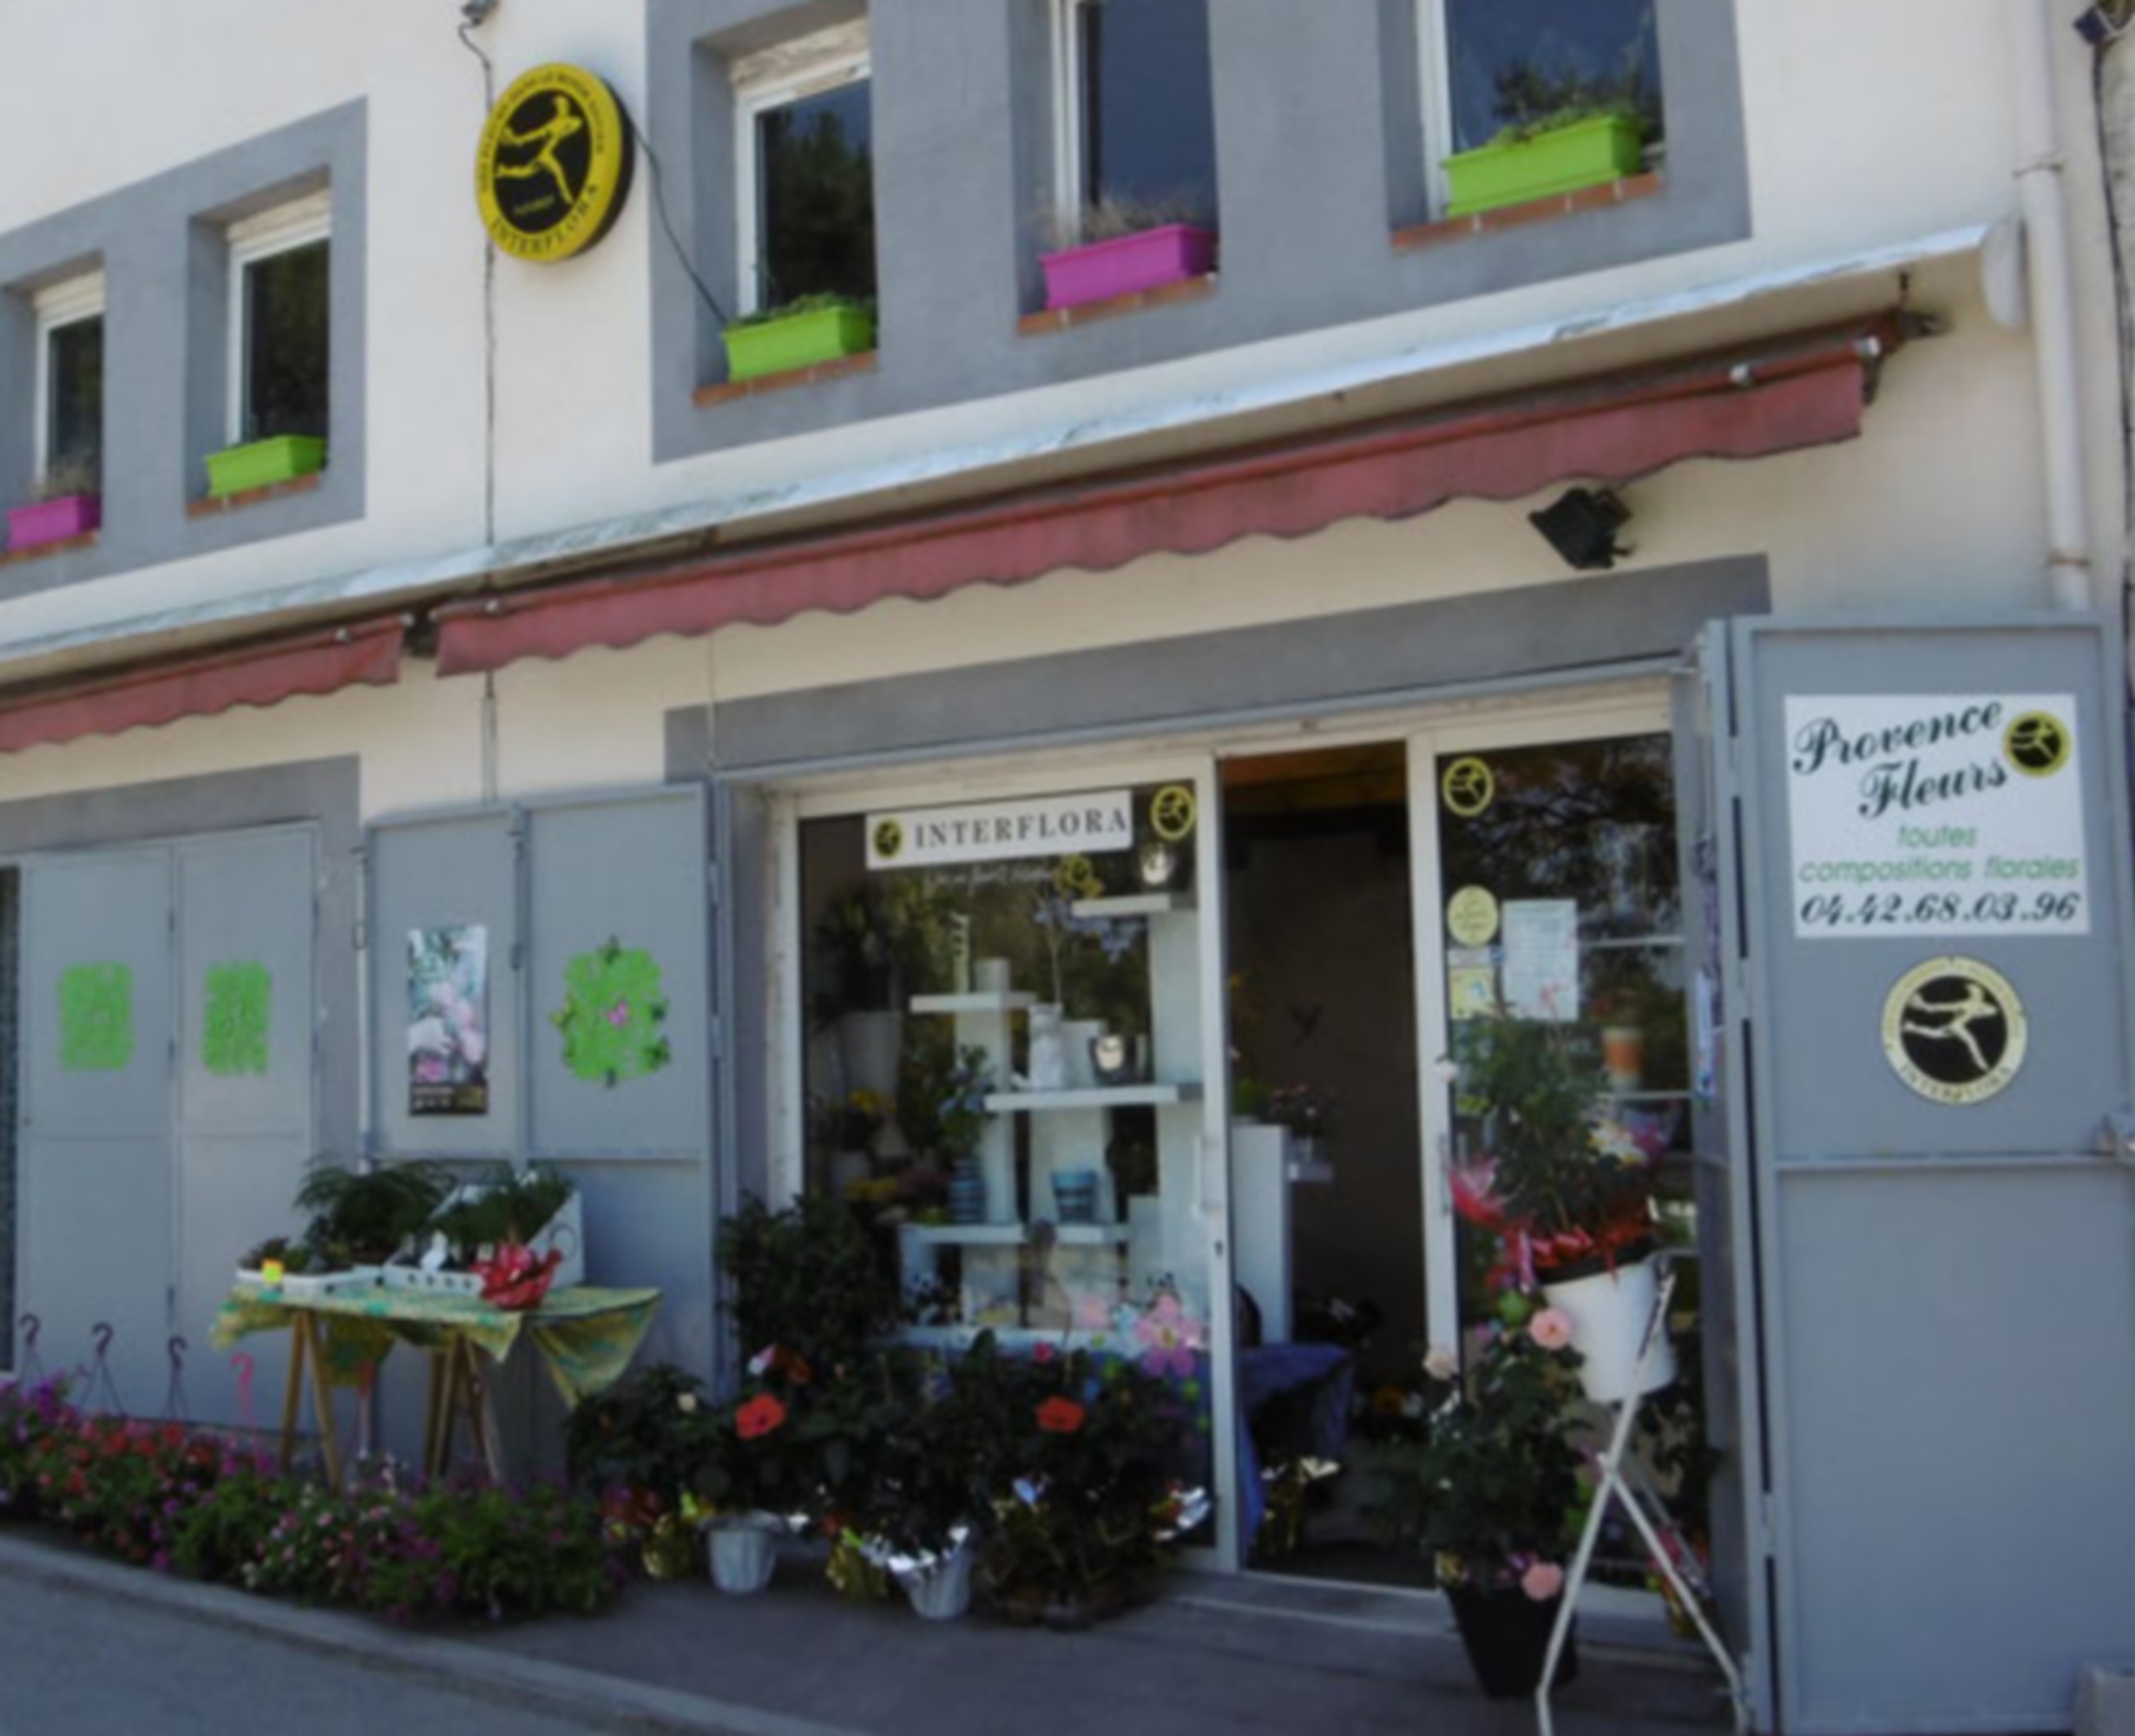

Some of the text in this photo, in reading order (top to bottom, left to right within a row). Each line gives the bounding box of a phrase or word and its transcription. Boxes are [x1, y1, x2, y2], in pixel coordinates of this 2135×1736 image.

[1792, 701, 2002, 776] Provence
[1858, 758, 2007, 819] Fleurs
[915, 808, 1127, 849] INTERFLORA
[1897, 825, 1978, 848] toutes
[1798, 855, 2080, 885] compositions florales
[1801, 891, 2081, 925] 04.42.68.03.96
